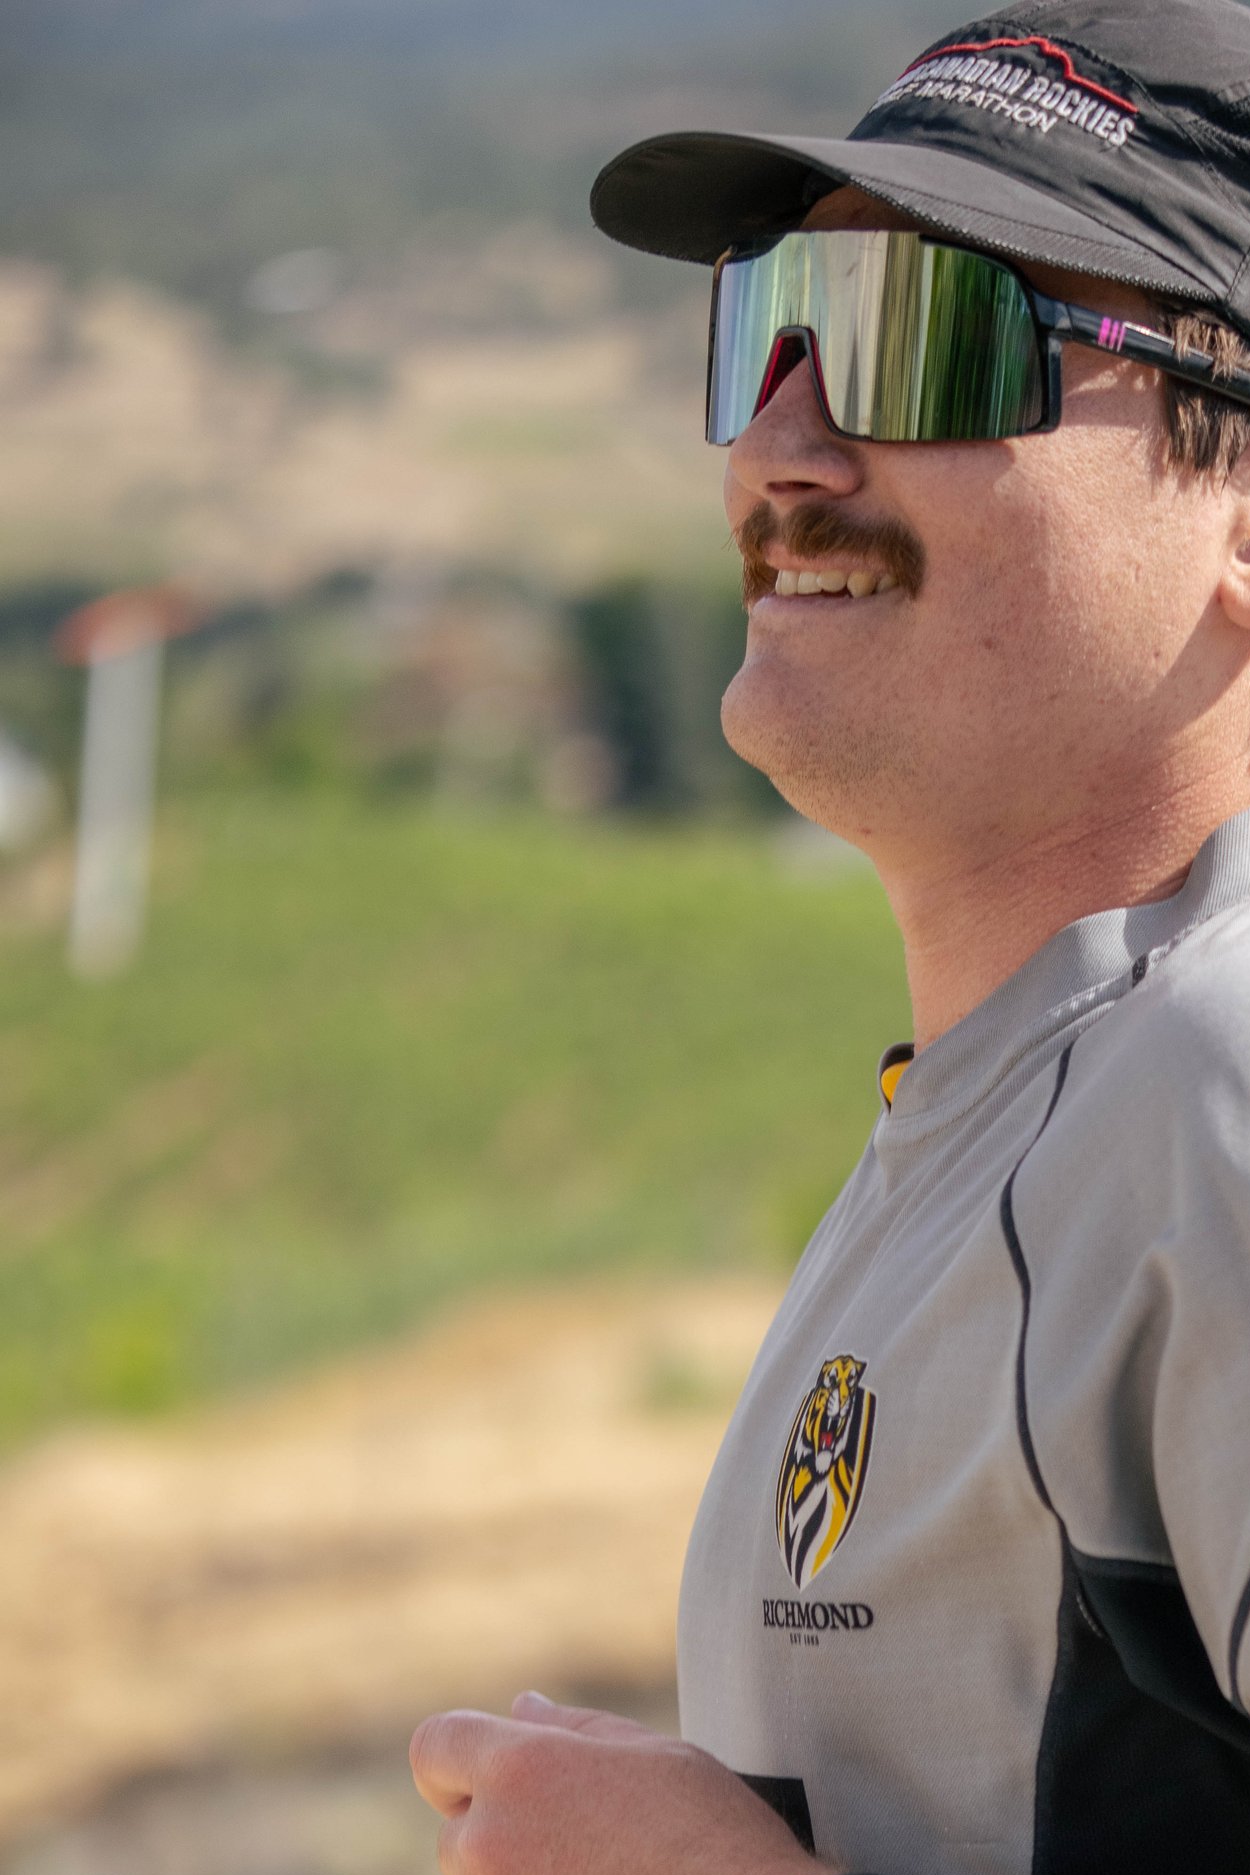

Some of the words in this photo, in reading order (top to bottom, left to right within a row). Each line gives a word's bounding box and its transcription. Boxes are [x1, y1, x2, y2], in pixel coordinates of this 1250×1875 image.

[915, 81, 1059, 134] MARATHON
[1022, 76, 1135, 147] ROCKIES
[762, 1598, 874, 1631] RICHMOND
